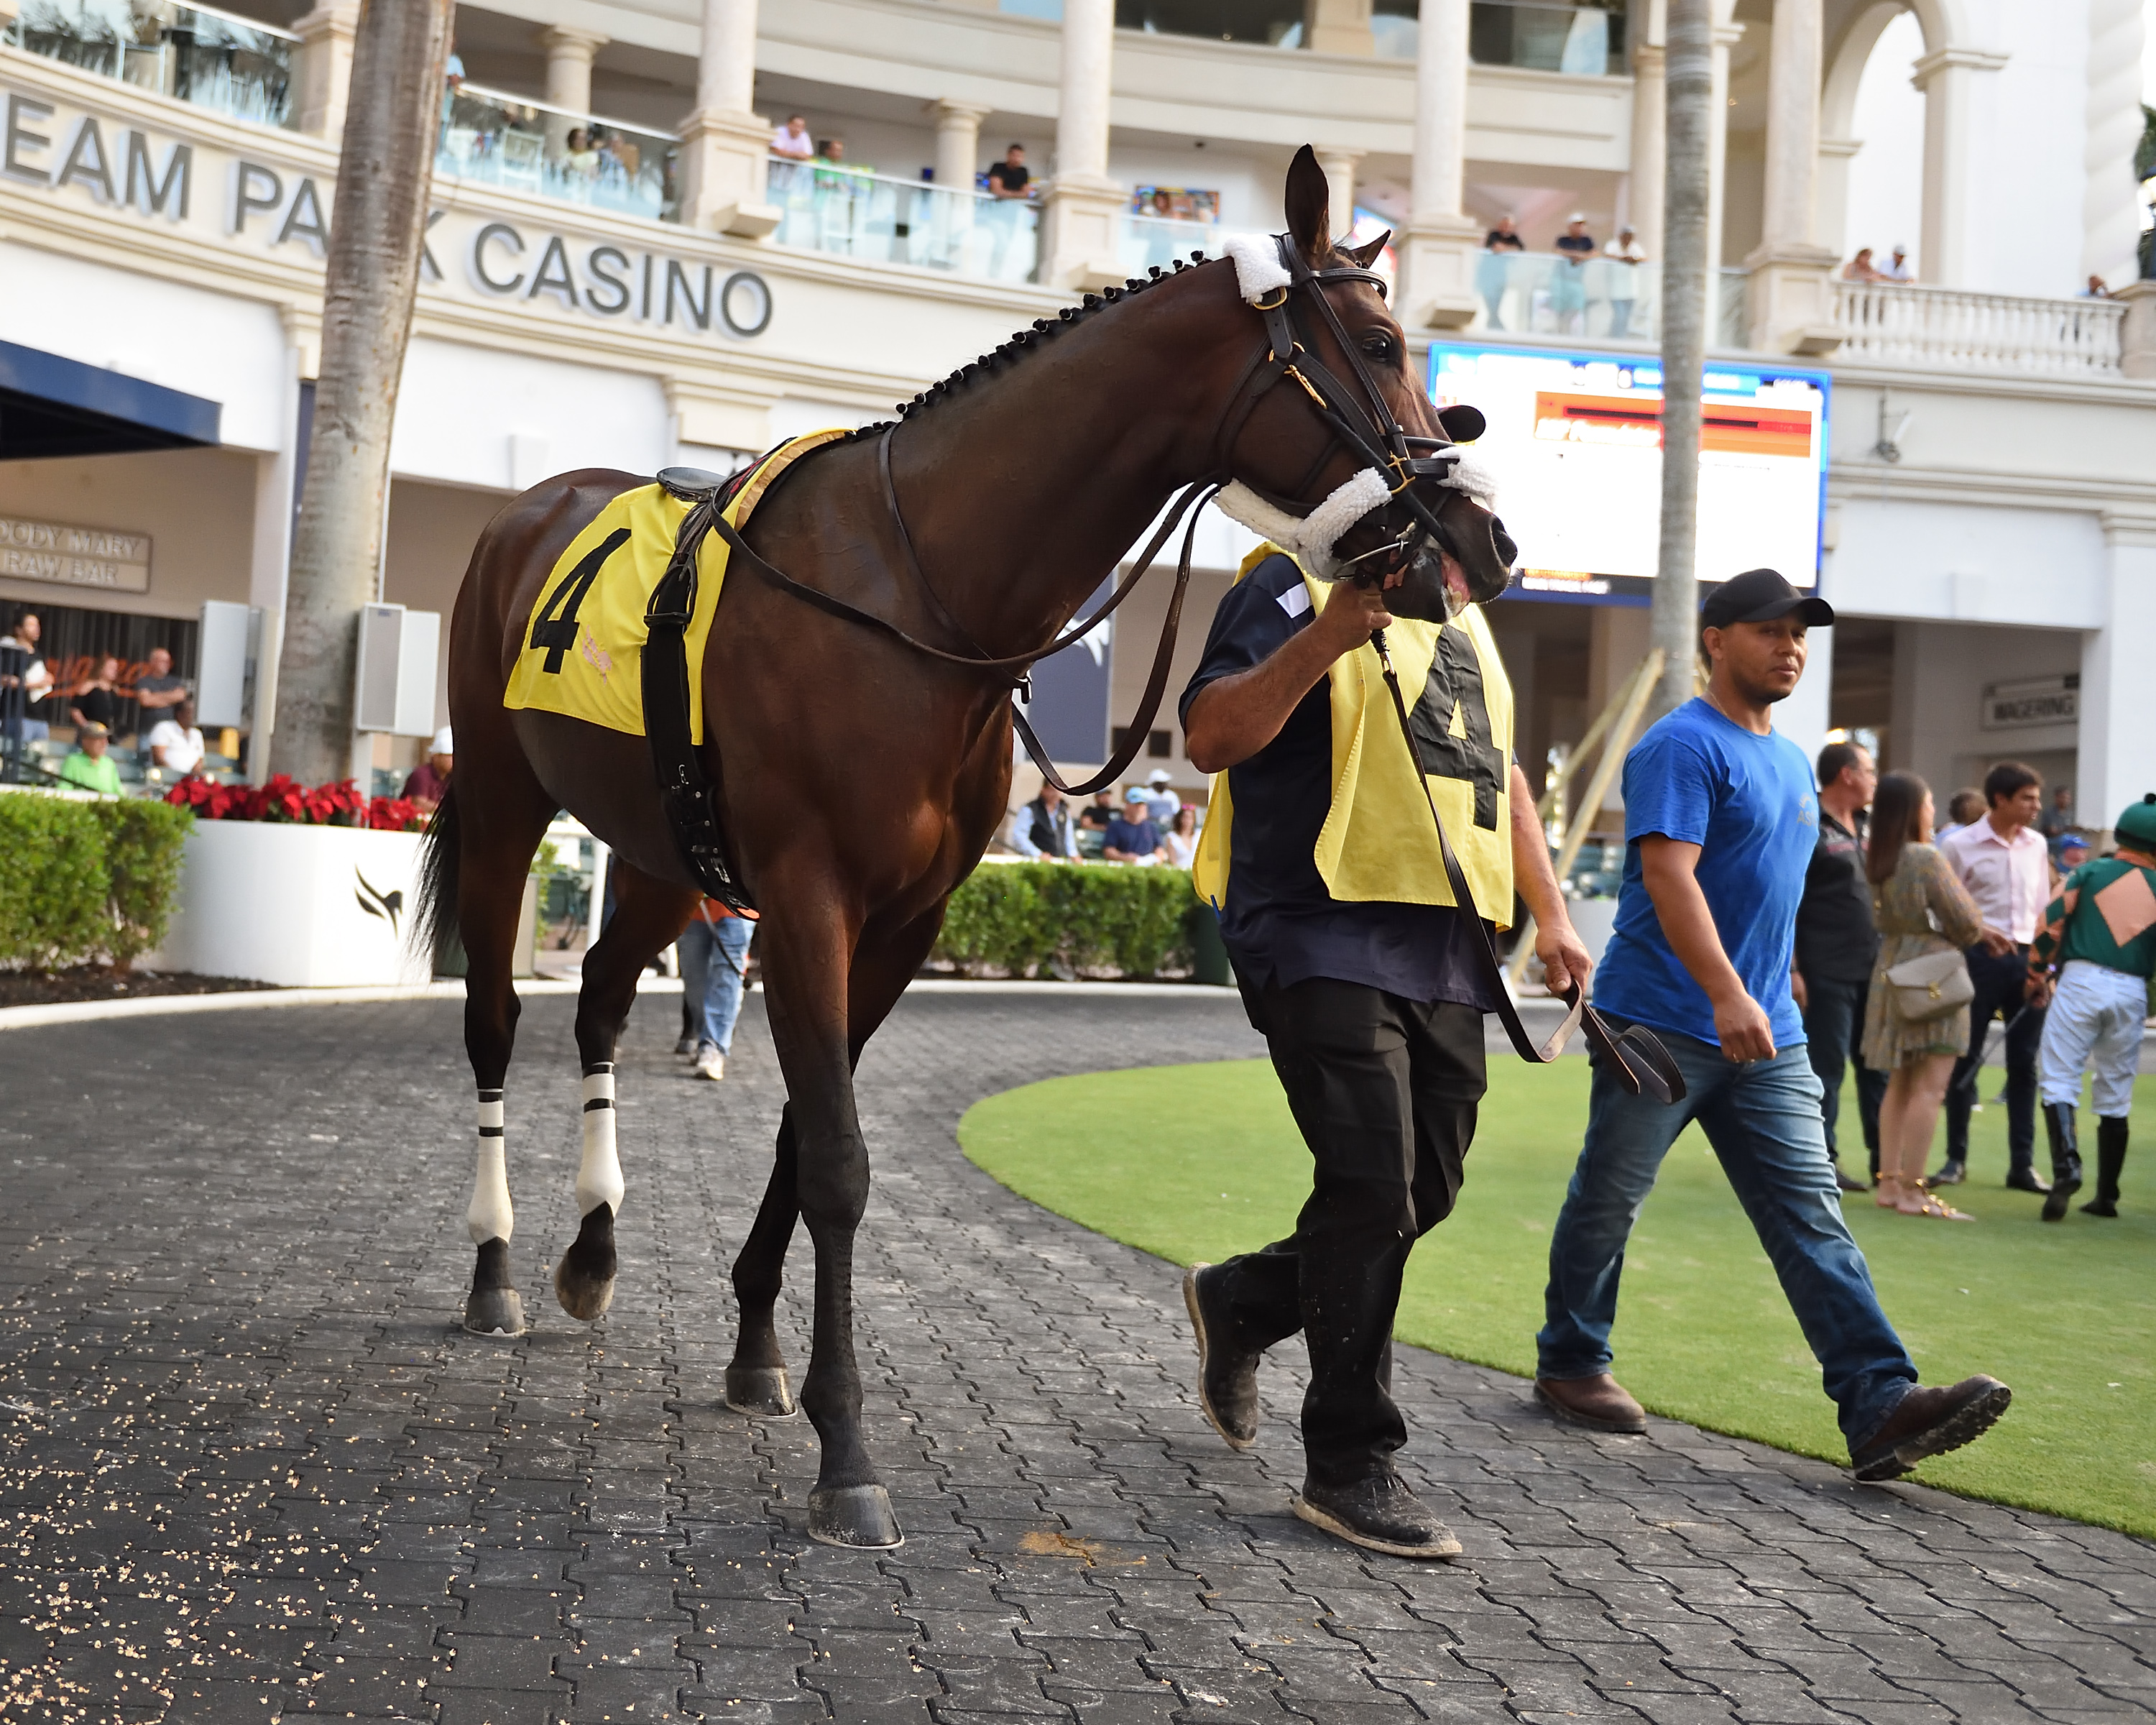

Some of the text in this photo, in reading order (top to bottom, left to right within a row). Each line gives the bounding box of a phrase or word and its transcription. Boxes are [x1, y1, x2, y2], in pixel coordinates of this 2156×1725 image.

[4, 93, 774, 338] EAM PAK CASINO
[4, 550, 119, 586] RAW BAR
[69, 530, 140, 559] MARY
[530, 528, 631, 674] 4
[1409, 625, 1504, 832] 4
[1993, 694, 2075, 720] WAGERING
